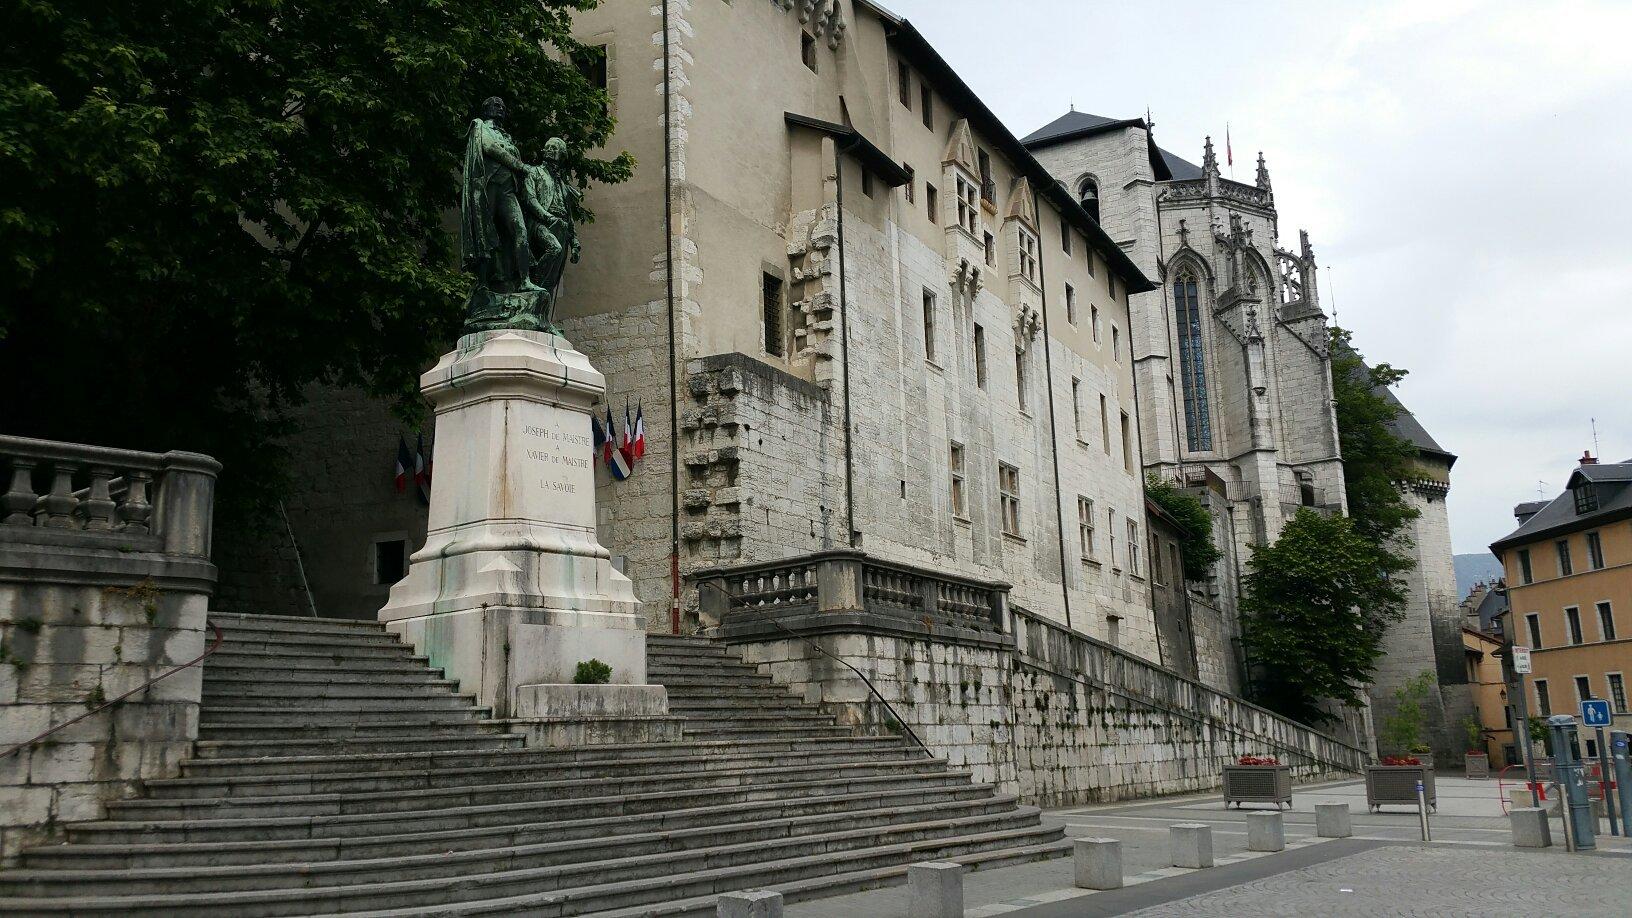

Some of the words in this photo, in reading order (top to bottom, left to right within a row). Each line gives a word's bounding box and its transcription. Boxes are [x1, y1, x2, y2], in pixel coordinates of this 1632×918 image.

[523, 425, 549, 438] JOSEPH
[551, 432, 560, 441] DE
[562, 433, 590, 446] MAISTRE
[526, 449, 549, 462] XAVIER
[551, 456, 559, 464] DE
[562, 455, 588, 469] MAISTRE
[540, 479, 549, 490] LA
[553, 481, 576, 494] SAVOIE
